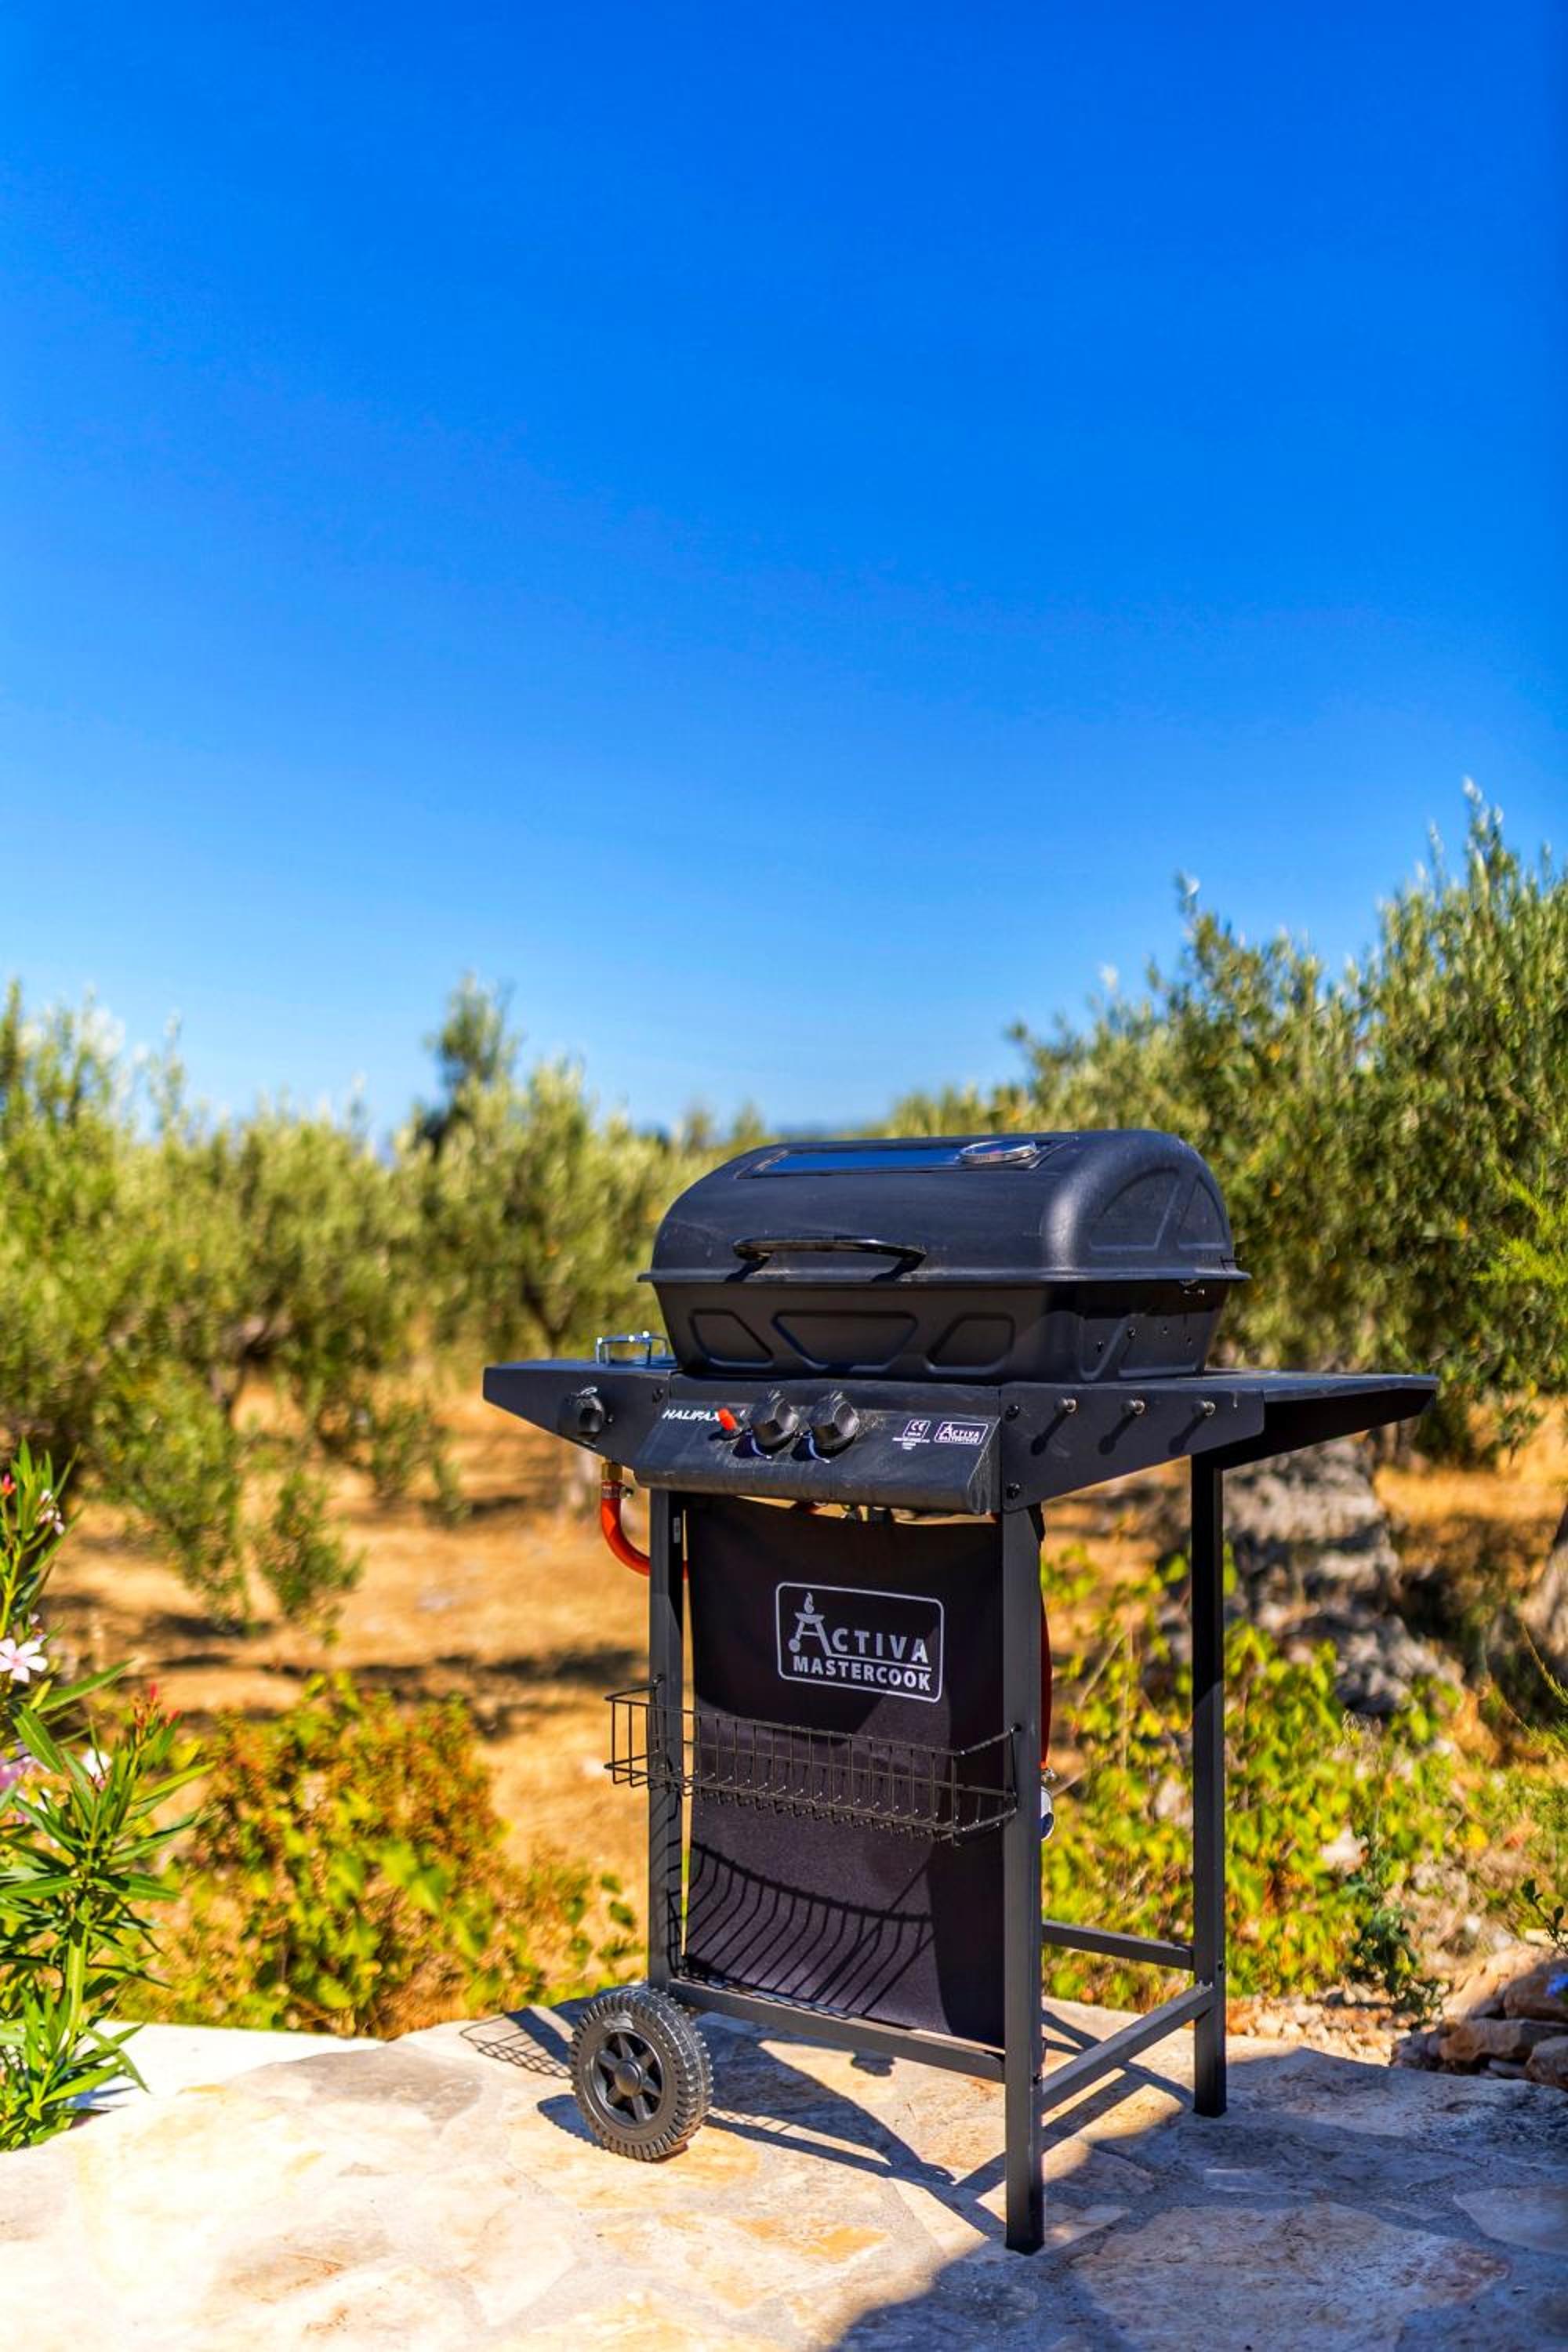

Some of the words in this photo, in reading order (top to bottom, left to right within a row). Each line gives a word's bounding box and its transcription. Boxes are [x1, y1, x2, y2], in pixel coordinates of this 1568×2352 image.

[939, 1425, 979, 1439] ACTIVA
[789, 1612, 928, 1664] ACTIVA
[793, 1655, 931, 1691] MASTERCOOK
